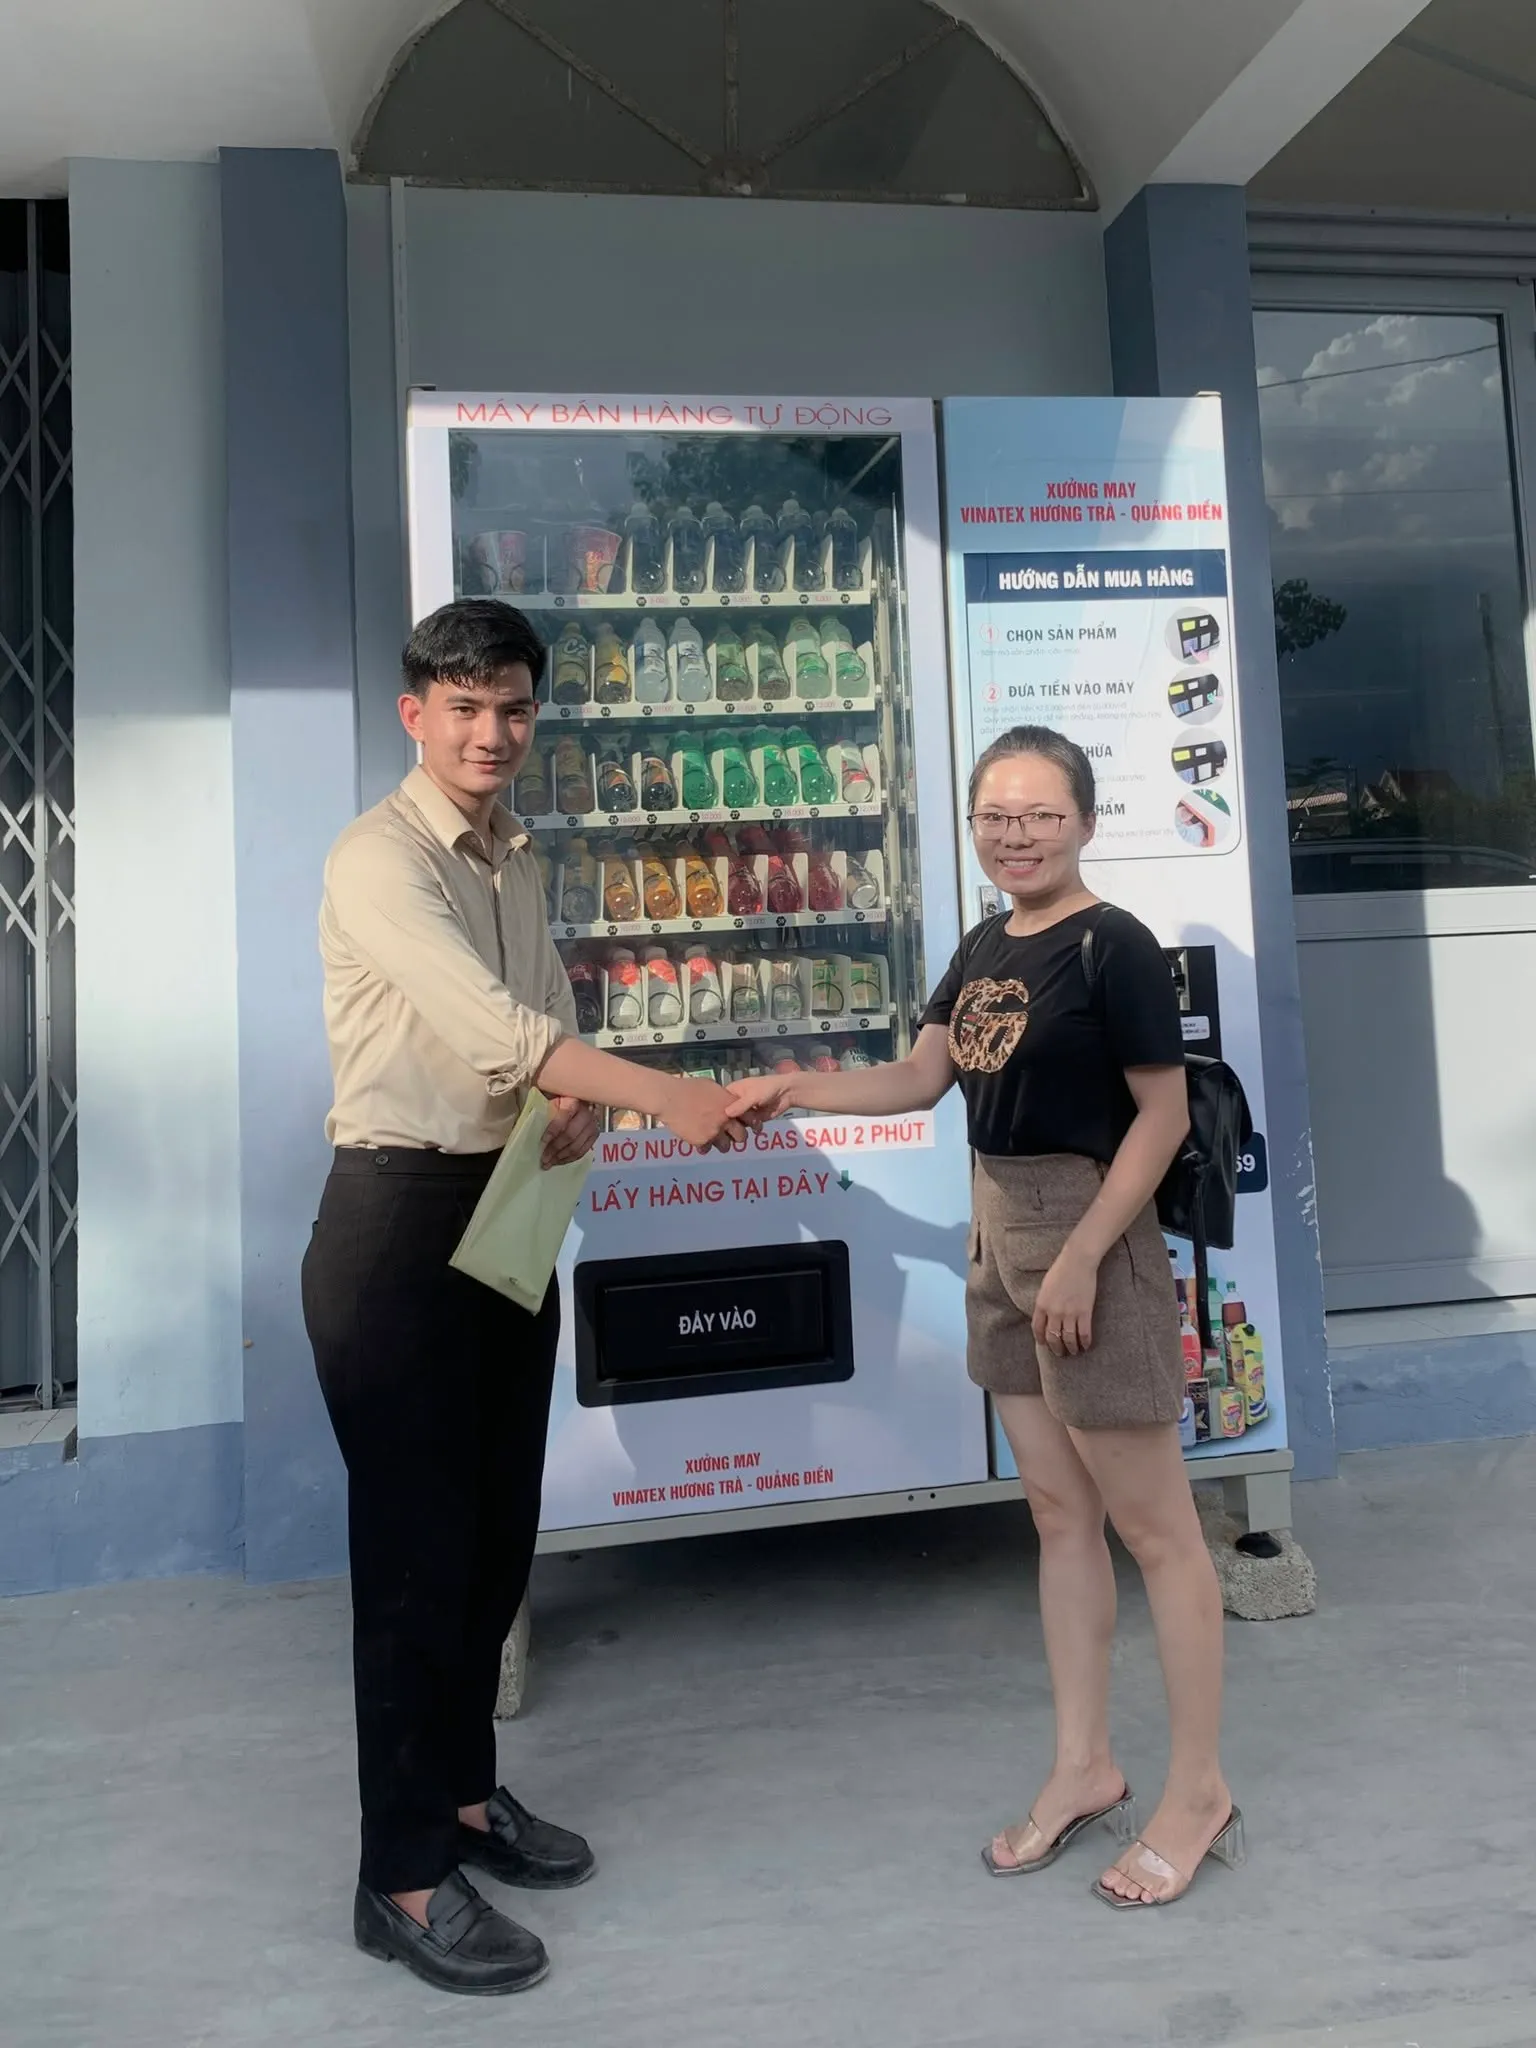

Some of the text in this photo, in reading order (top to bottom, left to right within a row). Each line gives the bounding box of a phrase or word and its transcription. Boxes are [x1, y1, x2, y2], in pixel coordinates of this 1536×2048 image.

[457, 399, 893, 432] MÁY BÁN HÀNG TỰ ĐỘNG
[1047, 477, 1136, 499] XƯỞNG MAY
[961, 506, 1025, 523] VINATEX
[1030, 504, 1082, 522] HƯƠNG
[1088, 501, 1115, 522] TRÀ
[1131, 500, 1182, 521] QUẢNG
[999, 563, 1194, 590] HƯỚNG DẪN MUA HÀNG
[987, 620, 1117, 643] 1 CHỌN SẢN PHẨM
[989, 688, 997, 700] 2
[1008, 683, 1035, 698] ĐƯA
[1075, 681, 1100, 696] VÀO
[1106, 680, 1135, 695] MÁY
[1094, 797, 1125, 816] HẨM
[603, 1137, 638, 1162] MỞ
[755, 1130, 798, 1151] GAS
[804, 1127, 847, 1149] SAU
[854, 1126, 864, 1144] 2
[871, 1118, 925, 1144] PHÚT
[592, 1171, 829, 1211] LẤY HÀNG TẠI ĐÂY
[719, 1305, 757, 1331] VÀO
[685, 1452, 761, 1475] XƯỞNG MAY
[613, 1488, 665, 1507] VINATEX
[670, 1482, 714, 1500] HƯƠNG
[719, 1476, 744, 1494] TRÀ
[756, 1469, 799, 1492] QUẢNG
